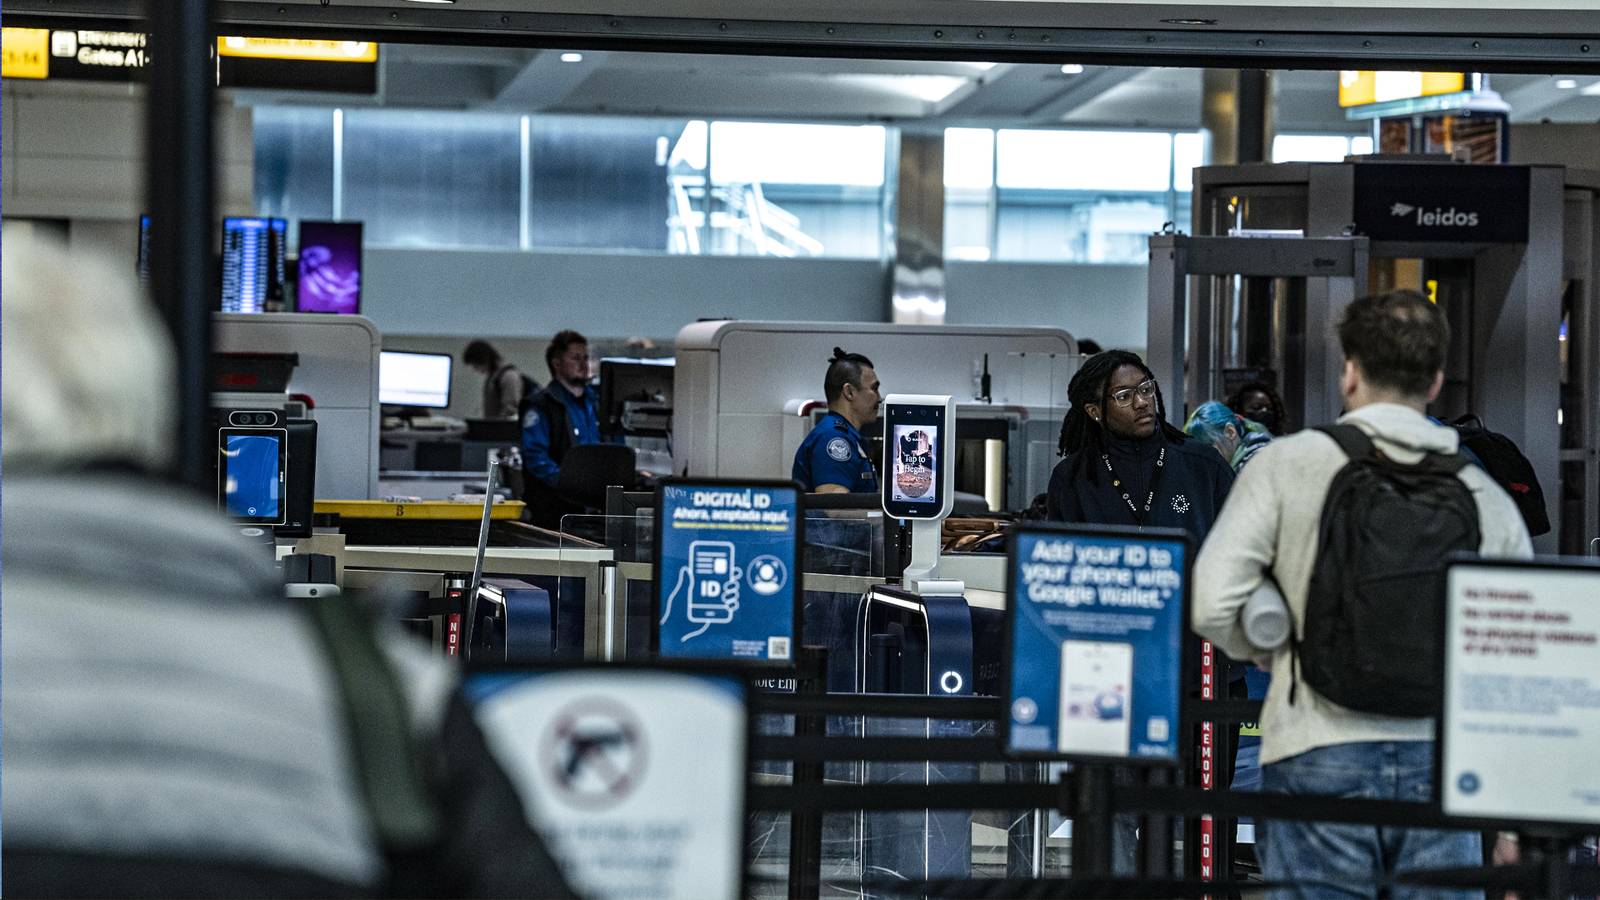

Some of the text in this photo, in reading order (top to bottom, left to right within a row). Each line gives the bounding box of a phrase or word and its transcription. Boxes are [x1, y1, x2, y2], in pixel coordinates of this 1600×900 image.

[1416, 207, 1479, 226] leidos
[905, 454, 926, 464] Tap to
[693, 491, 750, 508] DIGITAL
[753, 493, 771, 508] ID
[1031, 540, 1172, 568] Add your ID to
[1021, 563, 1181, 589] your phone with
[700, 580, 721, 598] ID
[1028, 582, 1096, 607] Google
[449, 622, 457, 656] NOT
[1203, 642, 1211, 666] DO
[1202, 721, 1211, 789] REMOV
[1203, 833, 1210, 858] DO
